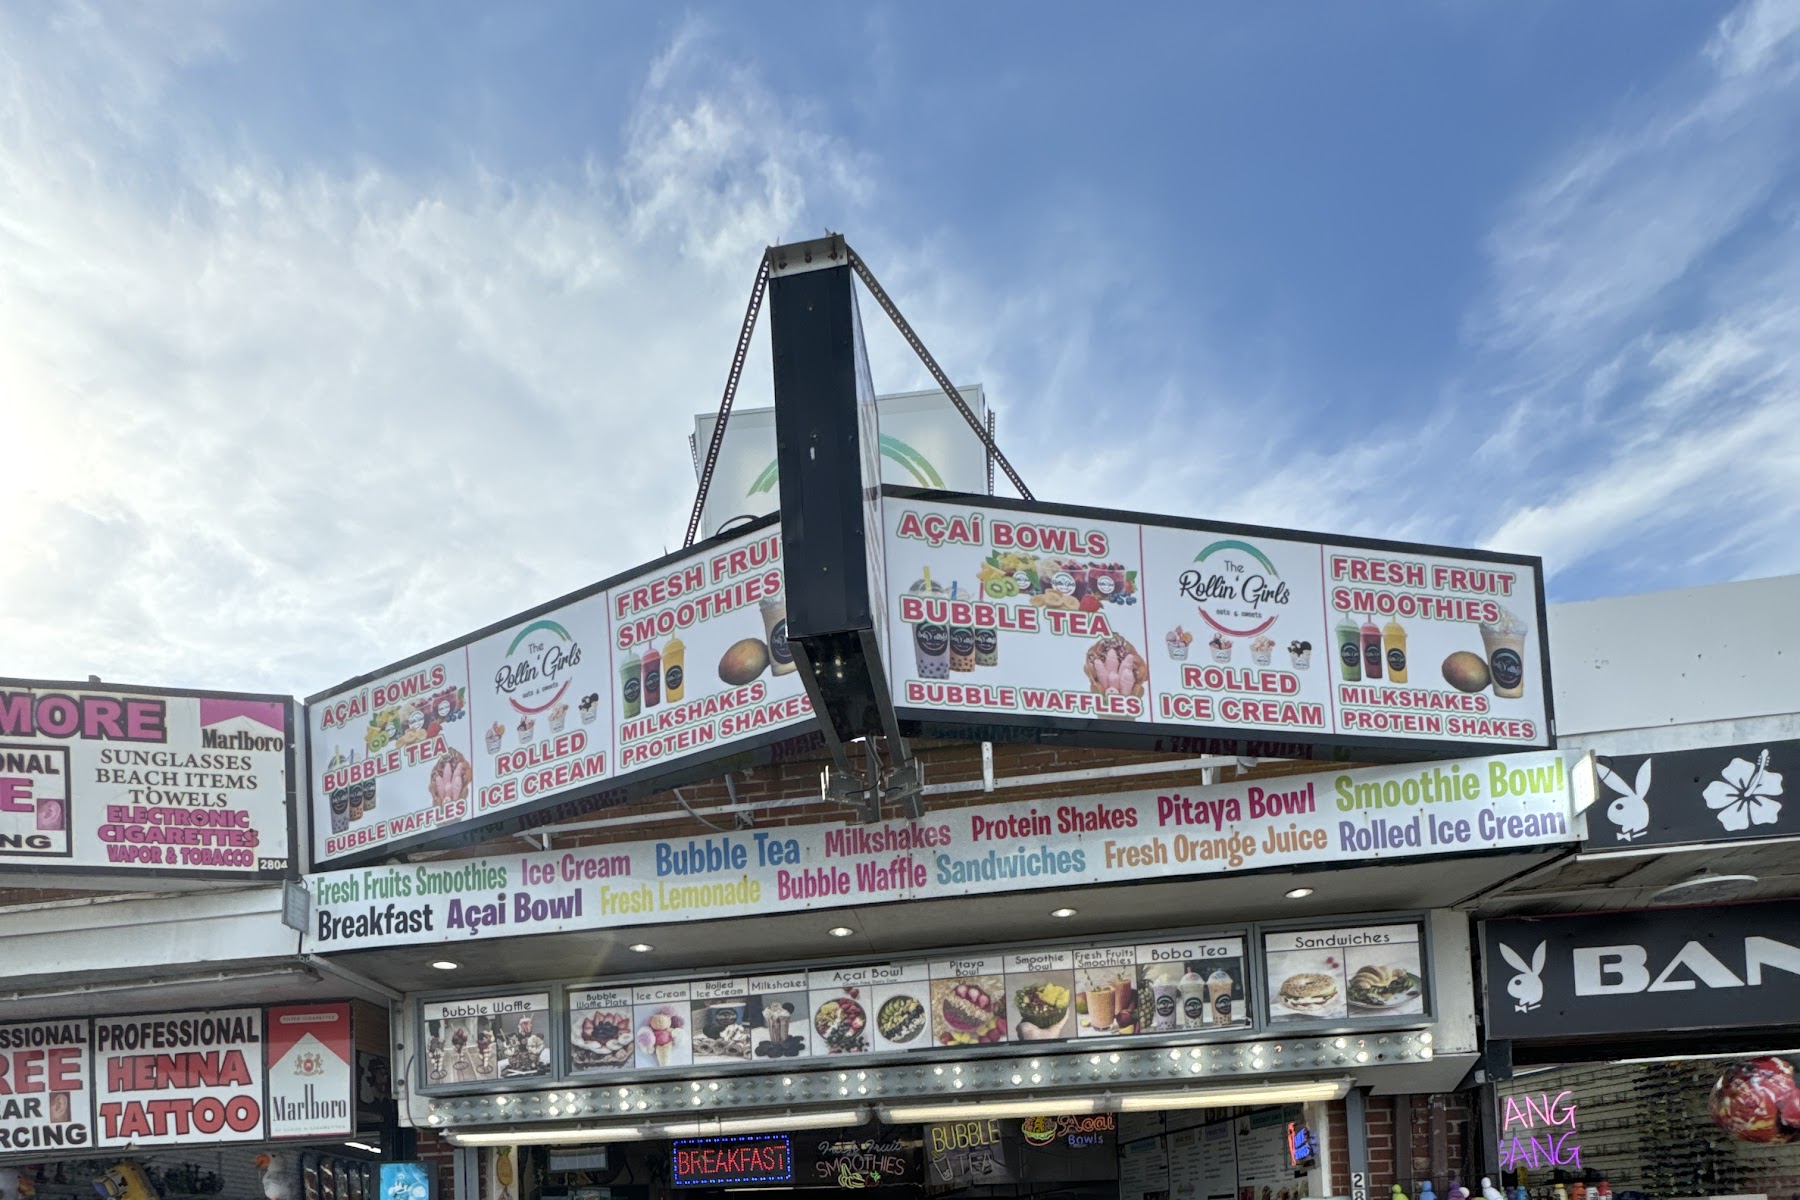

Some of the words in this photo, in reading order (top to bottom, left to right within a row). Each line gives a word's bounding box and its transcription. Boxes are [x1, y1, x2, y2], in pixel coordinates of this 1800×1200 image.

[899, 513, 982, 546] AÇAÍ
[993, 522, 1108, 557] BOWLS
[616, 565, 704, 618] FRESH
[712, 535, 782, 582] FRUI
[1223, 559, 1245, 573] The
[1332, 557, 1425, 587] FRESH
[1433, 567, 1515, 595] FRUIT
[1241, 574, 1291, 609] Girls
[618, 571, 782, 648] SMOOTHIES
[901, 597, 1039, 631] BUBBLE
[1045, 611, 1112, 637] TEA
[1334, 588, 1499, 623] SMOOTHIES
[527, 642, 545, 655] The
[541, 642, 582, 681] Girls
[1183, 666, 1298, 695] ROLLED
[320, 688, 369, 730] AÇAÍ
[373, 665, 446, 711] BOWLS
[907, 682, 1016, 708] BUBBLE
[1022, 690, 1142, 716] WAFFLES
[1161, 695, 1212, 719] ICE
[1220, 699, 1324, 726] CREAM
[1340, 687, 1489, 713] MILKSHAKES
[621, 682, 765, 743] MILKSHAKES
[1342, 710, 1442, 734] PROTEIN
[1446, 717, 1536, 740] SHAKES
[200, 728, 285, 752] Marlboro
[621, 724, 715, 766] PROTEIN
[720, 694, 814, 737] SHAKES
[99, 748, 253, 771] SUNGLASSES
[322, 751, 401, 794] BUBBLE
[404, 735, 450, 765] TEA
[496, 731, 587, 776] ROLLED
[95, 768, 179, 787] BEACH
[184, 772, 258, 791] ITEMS
[479, 780, 517, 808] ICE
[522, 753, 606, 796] CREAM
[128, 788, 229, 808] TOWELS
[106, 805, 250, 829] ELECTRONIC
[326, 823, 388, 855] BUBBLE
[389, 799, 467, 835] WAFFLES
[97, 824, 261, 848] CIGARETTES
[316, 873, 361, 906] Fresh
[363, 867, 412, 901] Fruits
[415, 859, 508, 897] Smoothies
[521, 858, 556, 887] Ice
[560, 852, 632, 882] Cream
[655, 836, 748, 878] Bubble
[753, 832, 801, 868] Tea
[824, 821, 952, 858] Milkshakes
[971, 808, 1053, 843] Protein
[1056, 802, 1139, 835] Shakes
[1156, 793, 1242, 833] Pitaya
[1247, 781, 1317, 821] Bowl
[1334, 763, 1481, 813] Smoothie
[1487, 756, 1565, 799] Bowl
[106, 844, 164, 865] VAPOR
[165, 845, 178, 865] &
[179, 847, 255, 868] TOBACCO
[259, 857, 289, 871] 2804
[317, 903, 435, 942] Breakfast
[513, 887, 584, 925] Bowl
[600, 882, 654, 916] Fresh
[658, 875, 762, 912] Lemonade
[776, 865, 851, 902] Bubble
[856, 856, 928, 893] Waffle
[935, 844, 1087, 886] Sandwiches
[1103, 836, 1169, 870] Fresh
[1173, 830, 1257, 868] Orange
[1261, 822, 1329, 856] Juice
[1338, 807, 1421, 852] Rolled
[1428, 813, 1472, 846] Ice
[1477, 807, 1567, 843] Cream
[1150, 946, 1193, 962] Boba
[1198, 944, 1228, 957] Tea
[1295, 931, 1392, 949] Sandwiches
[949, 959, 985, 971] Pitaya
[1014, 953, 1065, 965] Smoothie
[1028, 961, 1053, 972] Bowl
[1074, 951, 1104, 961] Fresh
[1105, 949, 1135, 959] Fruits
[1077, 956, 1133, 968] Smoothies
[705, 979, 735, 990] Rolled
[751, 977, 808, 992] Milkshakes
[871, 966, 905, 980] Bowl
[955, 966, 981, 977] Bowl
[576, 1000, 604, 1010] Waffle
[605, 997, 629, 1008] Plate
[585, 991, 618, 1002] Bubble
[636, 990, 653, 1001] Ice
[655, 988, 688, 1000] Cream
[696, 988, 712, 999] Ice
[713, 987, 744, 997] Cream
[441, 1003, 489, 1019] Bubble
[492, 999, 533, 1014] Waffle
[98, 1015, 261, 1052] PROFESSIONAL
[107, 1049, 254, 1094] HENNA
[0, 1097, 43, 1120] AR
[272, 1083, 348, 1123] Marlboro
[1503, 1089, 1578, 1132] ANG
[98, 1094, 261, 1140] TATTOO
[931, 1118, 1000, 1153] BUBBLE
[1067, 1133, 1104, 1146] Bowls
[677, 1145, 788, 1176] BREAKFAST
[815, 1154, 907, 1179] SMOOTHIES
[957, 1150, 996, 1176] TEA
